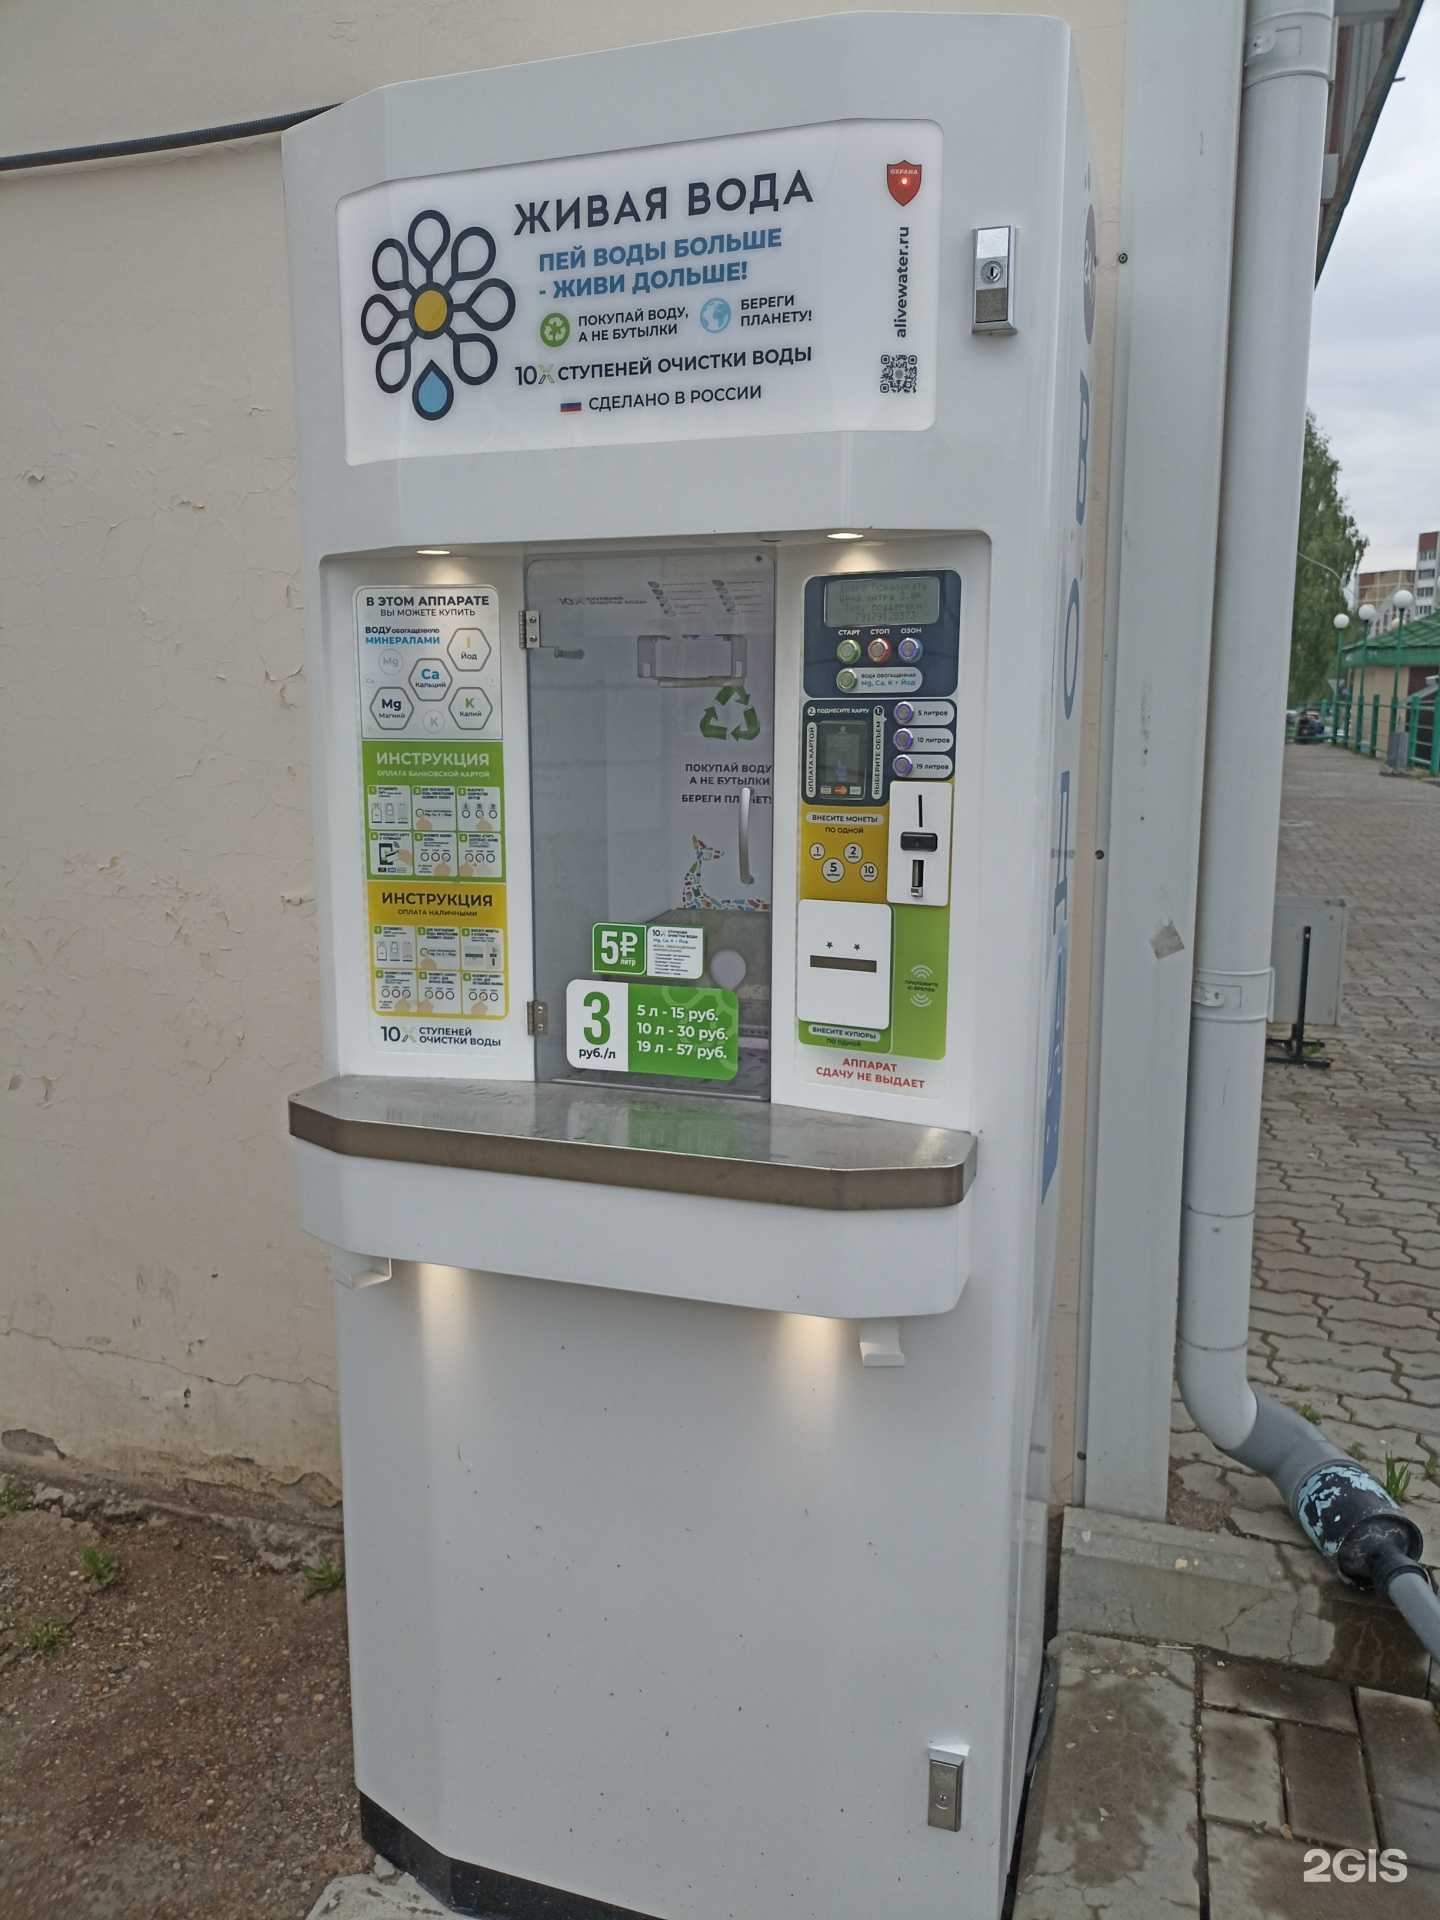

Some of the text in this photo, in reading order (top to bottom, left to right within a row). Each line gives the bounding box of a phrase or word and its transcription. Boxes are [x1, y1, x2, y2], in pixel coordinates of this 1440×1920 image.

[514, 169, 814, 236] ЖИВАЯ ВОДА
[539, 228, 782, 273] ПЕЙ ВОДЫ БОЛЬШЕ
[553, 274, 625, 299] ЖИВИ
[632, 261, 748, 295] ДОЛЬШЕ!
[893, 226, 910, 338] alivewater.ru
[740, 295, 795, 311] БЕРЕГИ
[578, 306, 690, 327] ПОКУПАЙ ВОДУ,
[740, 310, 813, 327] ПЛАНЕТУ!
[578, 324, 678, 342] А НЕ БУТЫЛКИ
[558, 357, 652, 381] СТУПЕНЕЙ
[657, 352, 747, 374] ОЧИСТКИ
[752, 346, 812, 366] ВОДЫ
[589, 385, 762, 412] СДЕЛАНО В РОССИИ
[366, 596, 490, 606] В ЭТОМ АППАРАТЕ
[380, 608, 476, 617] ВЫ МОЖЕТЕ КУПИТЬ
[365, 626, 391, 635] ВОДУ
[366, 636, 440, 645] МИНЕРАЛАМИ
[461, 653, 478, 661] Йод
[421, 668, 440, 680] Ca
[382, 699, 402, 711] Mg
[377, 752, 490, 767] ИНСТРУКЦИЯ
[685, 762, 738, 773] ПОКУПАЙ
[689, 776, 770, 786] А НЕ БУТЫЛКИ
[681, 794, 721, 804] БЕРЕГИ
[812, 814, 878, 823] ВНЕСИТЕ МОНЕТЫ
[850, 846, 857, 855] 2
[830, 862, 837, 873] 5
[864, 865, 875, 874] 10
[382, 892, 493, 908] ИНСТРУКЦИЯ
[583, 991, 611, 1046] 3
[637, 1005, 646, 1017] 5
[648, 1008, 658, 1017] л
[671, 1006, 685, 1019] 15
[689, 1009, 719, 1024] руб.
[419, 1026, 472, 1036] СТУПЕНЕЙ
[636, 1022, 652, 1034] 10
[654, 1026, 664, 1035] л
[678, 1025, 695, 1037] 30
[699, 1028, 729, 1042] руб.
[812, 1026, 876, 1039] ВНЕСИТЕ КУПЮРЫ
[419, 1036, 501, 1047] ОЧИСТКИ ВОДЫ
[578, 1047, 616, 1060] руб./л
[636, 1040, 652, 1053] 19
[654, 1043, 664, 1053] л
[677, 1044, 693, 1056] 57
[697, 1046, 728, 1060] руб.
[842, 1058, 897, 1072] АППАРАТ
[816, 1067, 925, 1088] СДАЧУ НЕ ВЫДАЕТ
